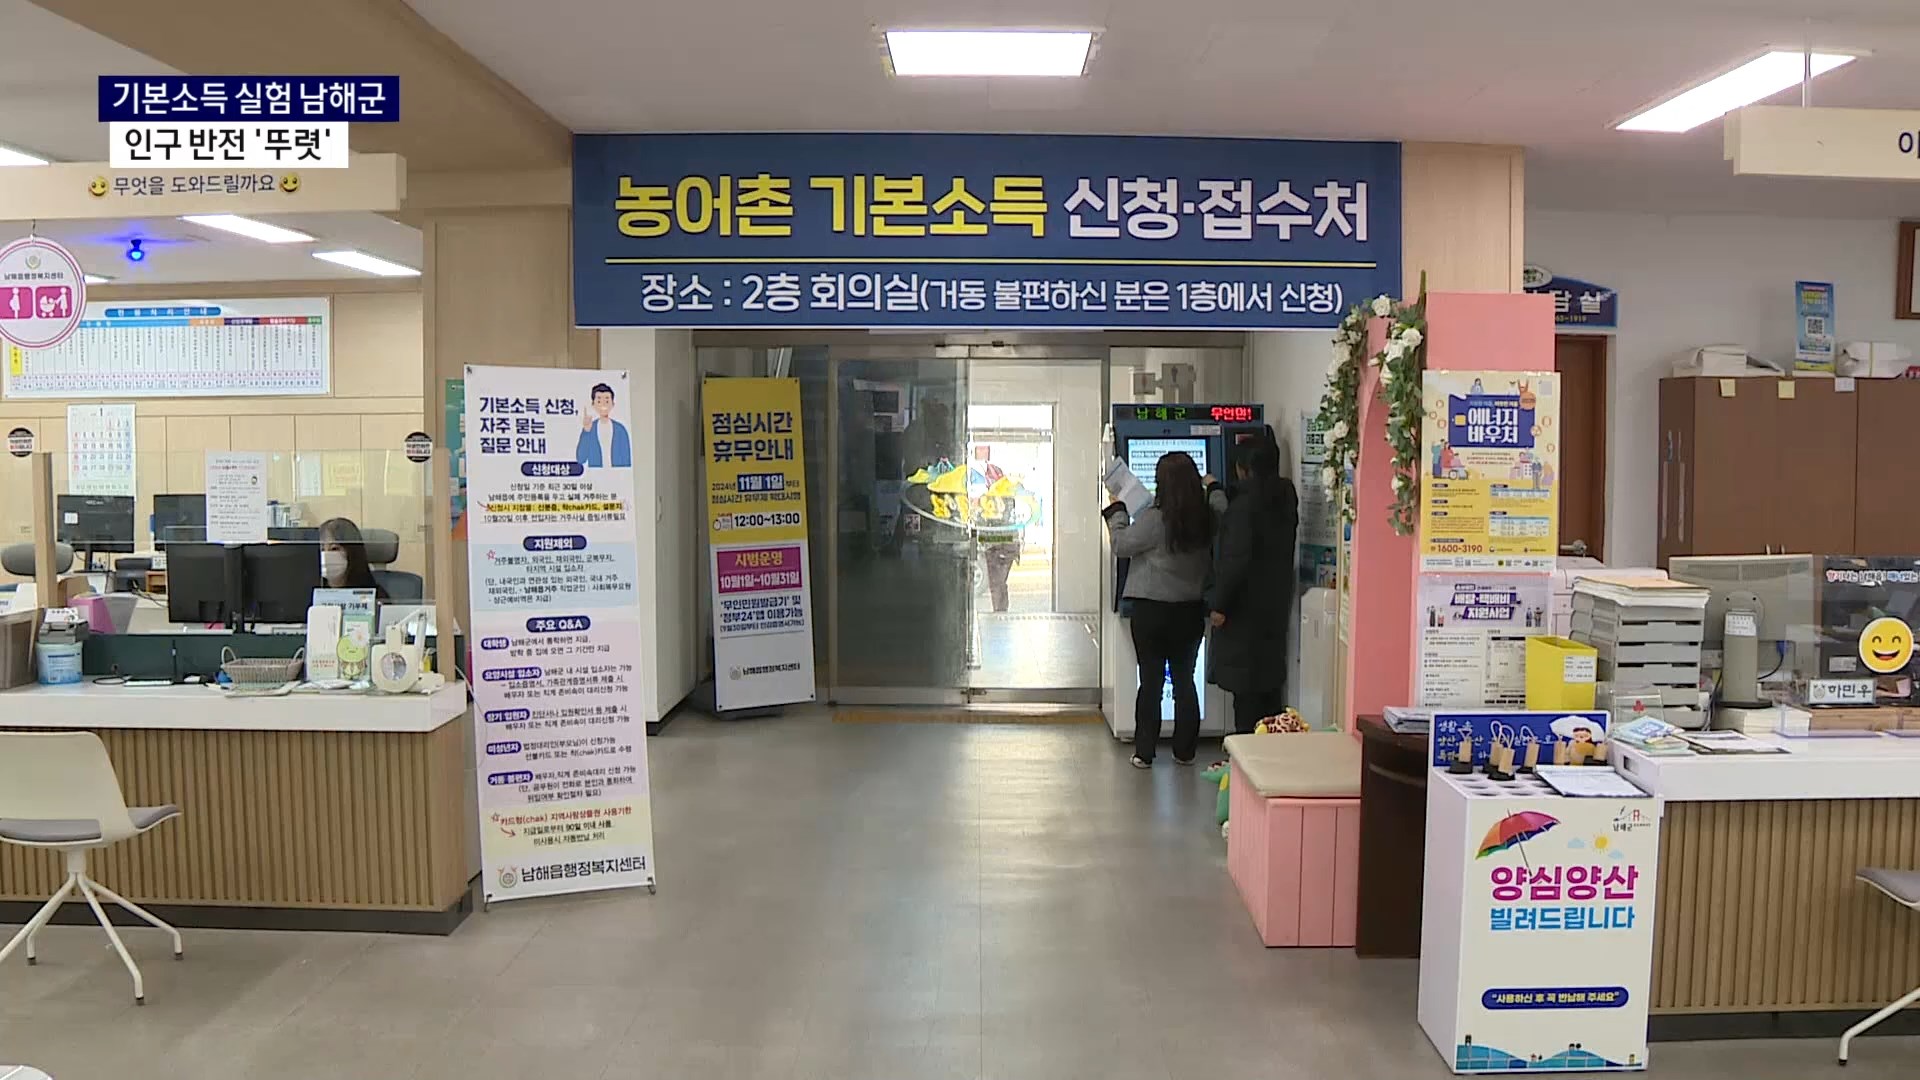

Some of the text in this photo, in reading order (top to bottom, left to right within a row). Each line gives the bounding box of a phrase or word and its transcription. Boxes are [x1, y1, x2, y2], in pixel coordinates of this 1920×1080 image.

[114, 174, 276, 196] 무엇을 도와드릴까요
[615, 173, 1369, 242] 농어촌 기본소득 신청·접수처
[641, 273, 714, 312] 장소
[741, 273, 801, 312] 2층
[810, 273, 987, 313] 회의실(거동
[993, 279, 1107, 313] 불편하신
[1114, 281, 1169, 313] 분은
[1177, 281, 1273, 314] 1층에서
[1279, 283, 1343, 315] 신청)
[479, 396, 579, 416] 기본소득 신청,
[1136, 407, 1186, 420] 남해군
[1467, 407, 1518, 426] 에너지
[480, 417, 545, 434] 자주 묻는
[712, 412, 793, 435] 점심시간
[1467, 425, 1519, 443] 바우처
[480, 437, 546, 454] 질문 안내
[713, 438, 794, 463] 휴무안내
[531, 464, 571, 476] 신청대상
[510, 482, 593, 491] 신청일 기준 30일 이상
[712, 475, 800, 491] 2024년 11월 1일 부터
[552, 493, 565, 501] 두고
[567, 493, 581, 501] 실제
[583, 493, 608, 501] 거주하는
[483, 514, 514, 523] 10월20일
[515, 513, 528, 522] 이후
[734, 512, 800, 528] 12:00~13:00
[534, 537, 573, 550] 지원제외
[1437, 544, 1483, 553] 1600-3190
[532, 555, 555, 565] 외국인,
[735, 551, 784, 568] 시범운영
[548, 564, 584, 573] 시설 입소자
[566, 575, 588, 584] 외국인,
[605, 573, 618, 582] 거주
[720, 571, 800, 590] 10월1일~10월31일
[792, 595, 801, 606] 및
[767, 607, 803, 620] 이용가능
[1467, 606, 1511, 619] 지원사업
[535, 618, 584, 632] 주요 Q&A
[511, 638, 545, 647] 남해군에서
[551, 647, 564, 655] 오면
[575, 645, 595, 654] 기간만
[597, 644, 610, 653] 지급
[544, 668, 564, 677] 남해군
[575, 666, 589, 675] 시설
[591, 665, 617, 674] 입소자는
[619, 664, 632, 673] 가능
[743, 662, 801, 676] 남해읍행정복지센터
[615, 684, 629, 693] 가능
[1827, 684, 1872, 699] 하민우
[617, 715, 630, 724] 가능
[623, 765, 637, 774] 가능
[584, 778, 605, 788] 본인과
[550, 809, 601, 821] 지역사랑상품권
[603, 806, 632, 816] 사용기한
[523, 825, 564, 836] 지급일로부터
[566, 823, 581, 832] 90일
[583, 821, 597, 830] 이내
[521, 856, 646, 882] 남해읍행정복지센터
[1490, 865, 1639, 901] 양심양산
[1490, 905, 1635, 931] 빌려드립니다
[1535, 993, 1545, 1003] 후
[1547, 993, 1556, 1003] 꼭
[1558, 992, 1586, 1003] 반납해
